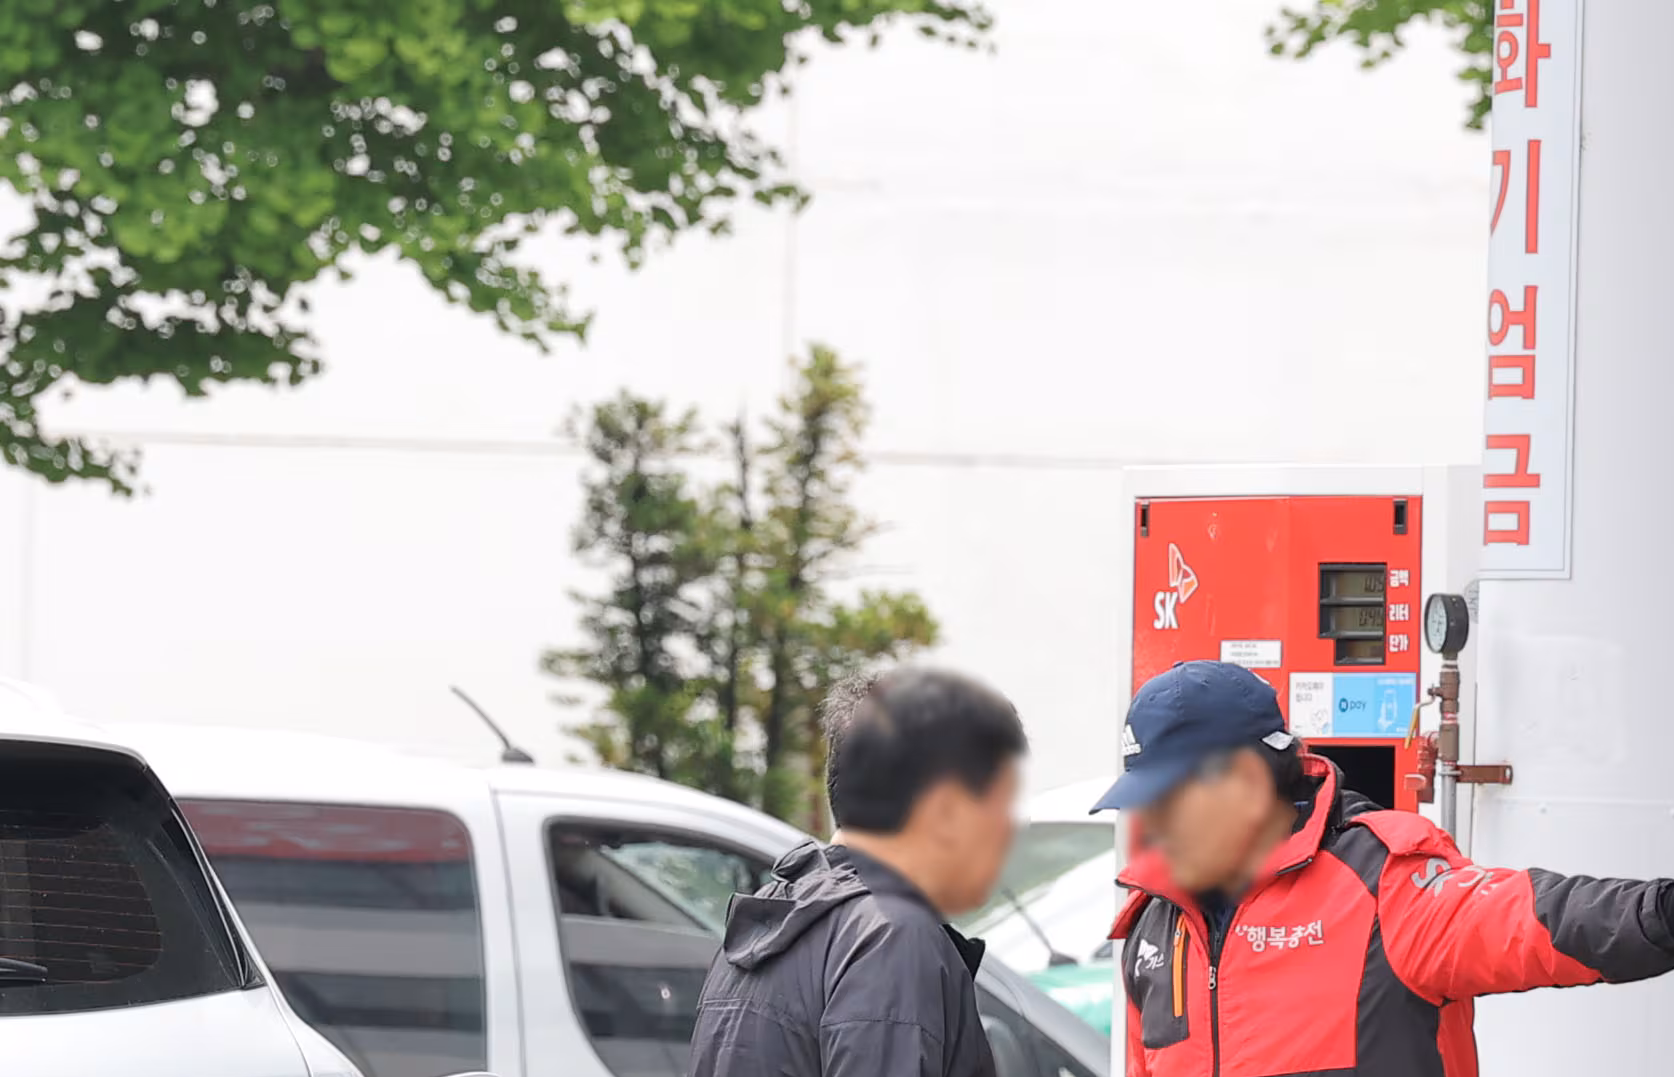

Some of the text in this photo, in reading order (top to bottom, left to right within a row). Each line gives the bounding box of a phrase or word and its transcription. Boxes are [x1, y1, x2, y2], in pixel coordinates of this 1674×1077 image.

[1482, 0, 1551, 546] 화기엄금
[1389, 569, 1409, 588] 금액
[1153, 591, 1178, 630] SK
[1388, 603, 1409, 621] 리터
[1388, 633, 1409, 652] 단가
